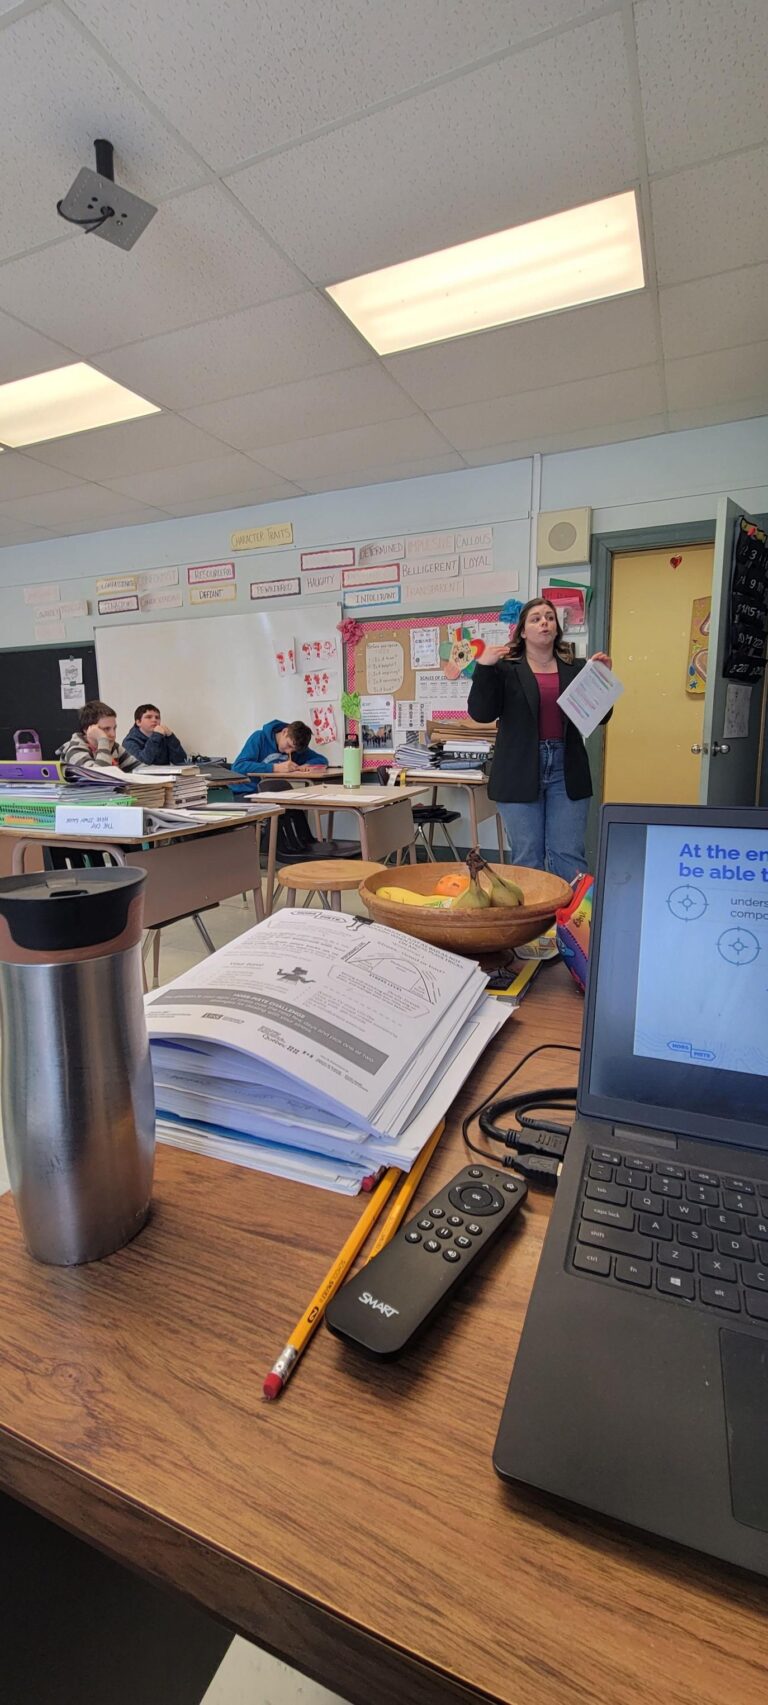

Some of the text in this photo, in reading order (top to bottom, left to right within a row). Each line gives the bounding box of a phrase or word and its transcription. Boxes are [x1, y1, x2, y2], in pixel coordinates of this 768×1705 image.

[231, 527, 292, 548] CHARACTER TRAITS
[457, 534, 492, 549] CALLOUS
[463, 555, 491, 570] LOYAL
[402, 560, 457, 577] BELLIGERENT
[199, 589, 224, 600] DEFIANT
[679, 843, 702, 858] At
[706, 844, 741, 860] the
[679, 862, 705, 878] be
[709, 864, 756, 882] able
[730, 897, 768, 908] unders
[643, 1197, 652, 1206] Q
[679, 1206, 689, 1214] W
[719, 1215, 727, 1223] E
[651, 1221, 660, 1230] A
[758, 1224, 767, 1233] R
[590, 1230, 605, 1239] shift
[690, 1231, 699, 1239] S
[731, 1241, 740, 1249] D
[586, 1254, 598, 1262] ctrl
[671, 1250, 679, 1259] Z
[629, 1265, 638, 1273] fn
[713, 1260, 721, 1270] X
[756, 1272, 766, 1282] C
[358, 1290, 400, 1318] SMART
